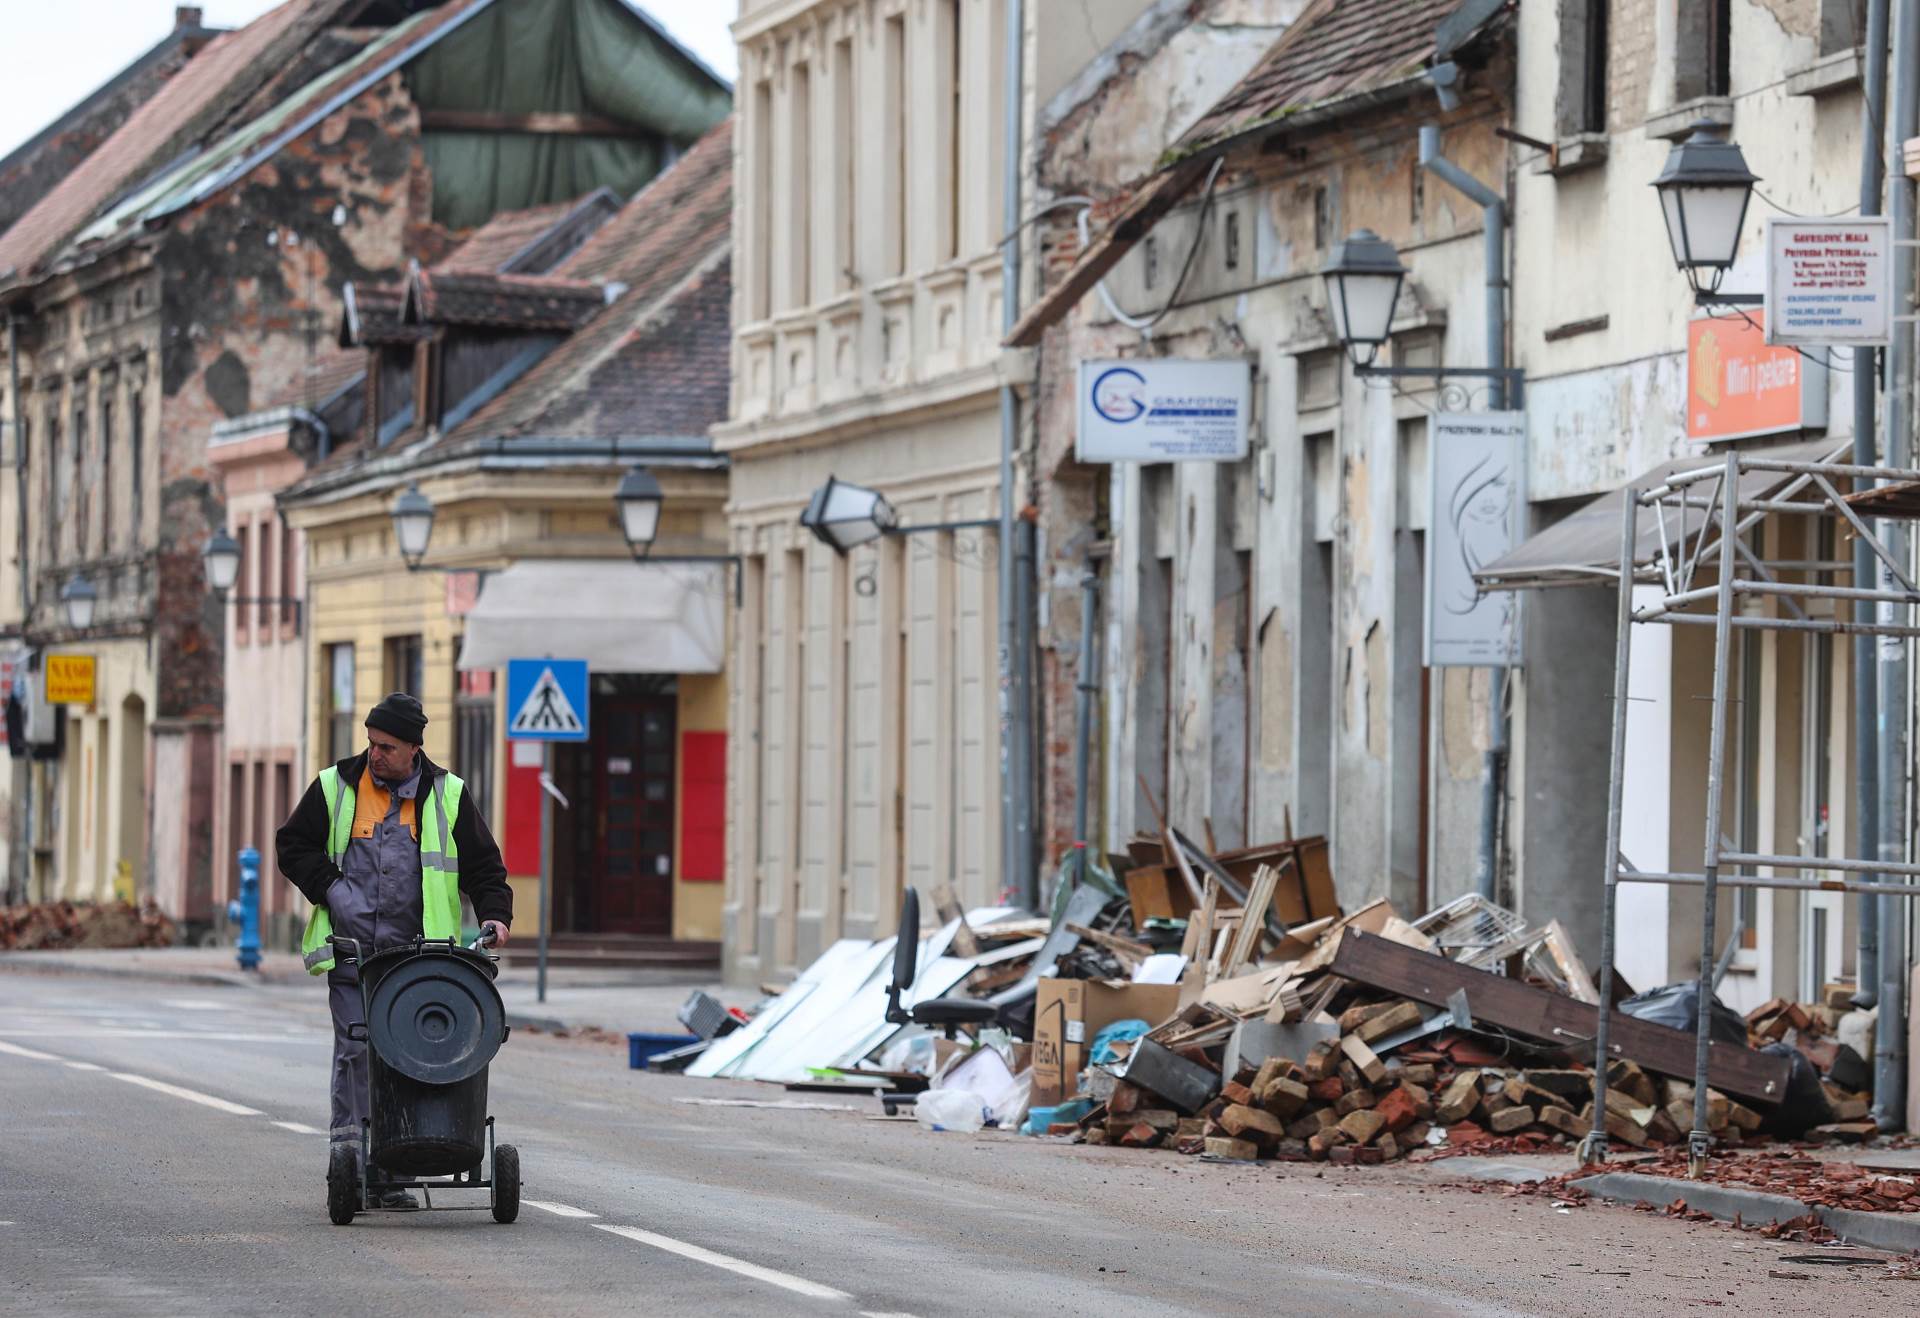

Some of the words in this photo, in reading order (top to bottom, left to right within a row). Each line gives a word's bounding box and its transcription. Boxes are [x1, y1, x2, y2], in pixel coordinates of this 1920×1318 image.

[1793, 233, 1841, 243] GAVRILOVIĆ
[1845, 234, 1869, 243] MALA
[1784, 248, 1822, 257] PRIVREDA
[1825, 248, 1860, 257] PETRINJA
[1756, 352, 1796, 400] pekare
[1153, 396, 1239, 405] GRAFOTON
[1034, 1040, 1060, 1065] VEGA
